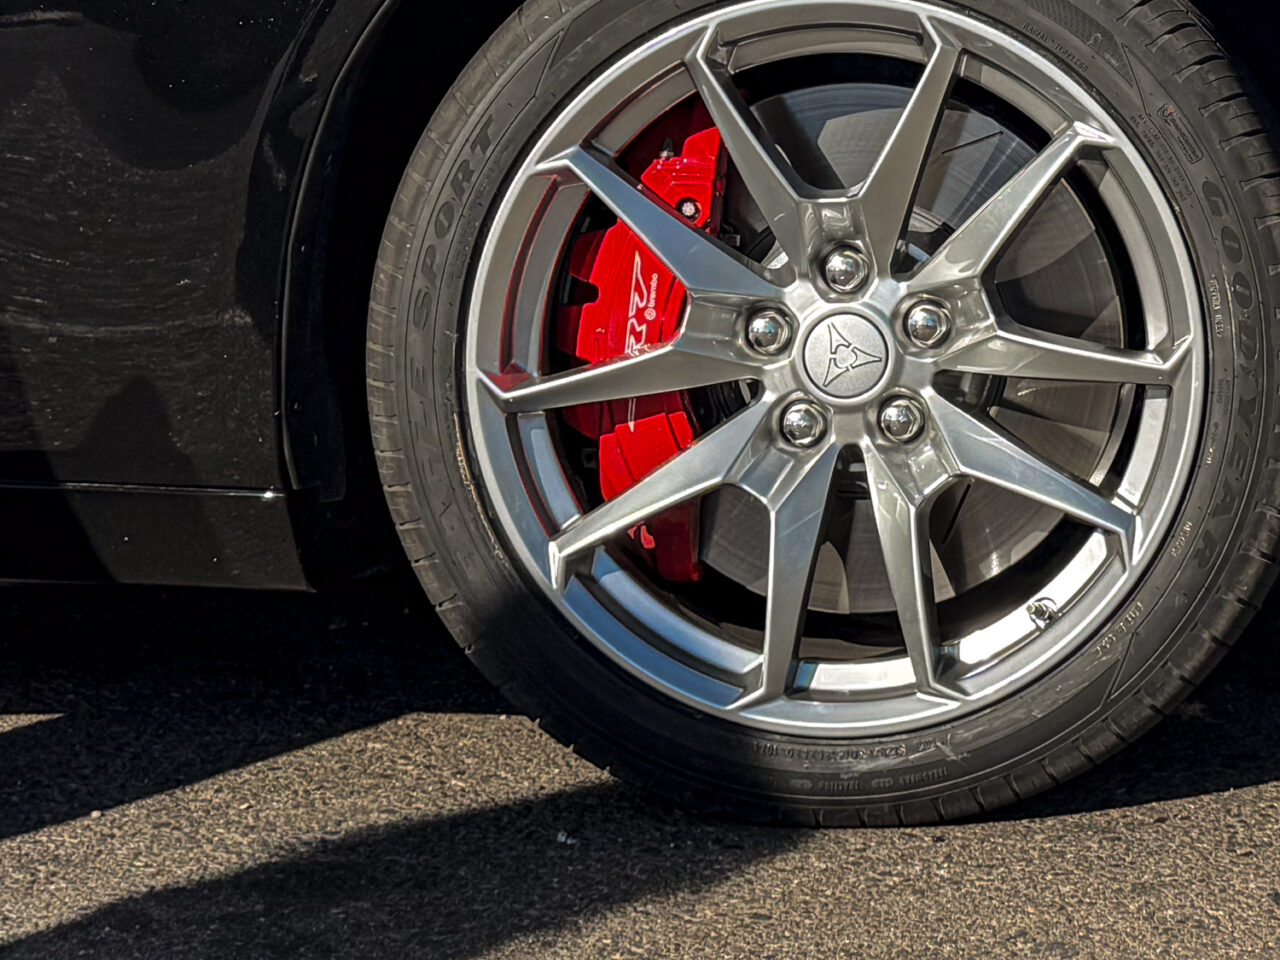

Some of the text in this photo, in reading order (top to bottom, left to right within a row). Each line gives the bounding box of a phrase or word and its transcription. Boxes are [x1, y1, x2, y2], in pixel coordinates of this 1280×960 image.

[413, 114, 494, 330] SPORT
[649, 272, 659, 308] brembo
[1195, 178, 1258, 571] GOODYEAR
